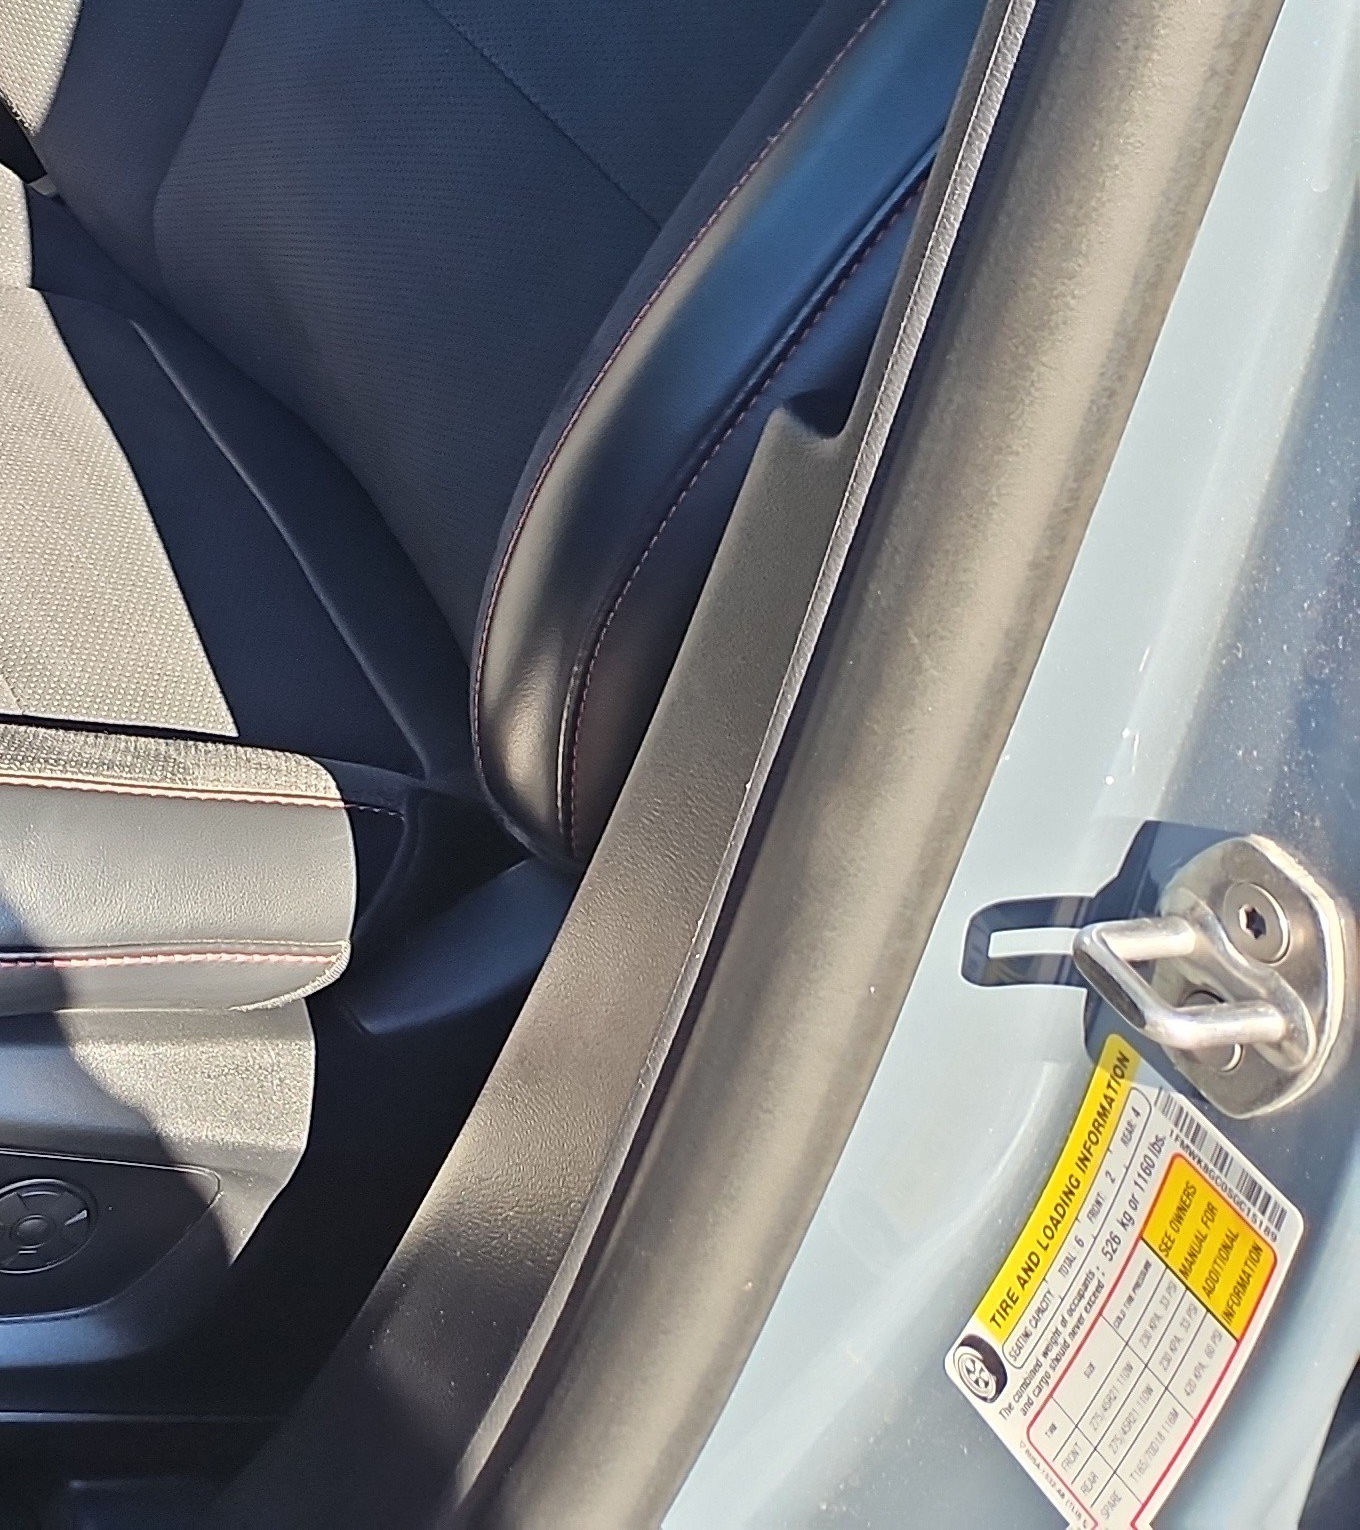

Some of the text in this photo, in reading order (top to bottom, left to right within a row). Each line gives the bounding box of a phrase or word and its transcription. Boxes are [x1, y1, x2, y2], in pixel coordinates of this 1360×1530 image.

[1131, 1105, 1141, 1119] 4
[989, 1050, 1130, 1329] TIRE AND LOADING INFORMATION
[1101, 1133, 1167, 1262] 526 kg or 1160 lbs.
[1105, 1170, 1116, 1184] 2
[1074, 1234, 1085, 1249] 6
[1158, 1180, 1197, 1258] SEE OWNERS
[1178, 1201, 1219, 1281] MANUAL FOR
[1200, 1228, 1240, 1299] ADDITIONAL
[1221, 1239, 1264, 1325] INFORMATION
[998, 1268, 1096, 1421] The combined weight of occupants
[1008, 1288, 1055, 1362] SEATING CAPACITY
[1020, 1396, 1035, 1417] and
[1032, 1370, 1053, 1397] cargo
[1048, 1337, 1071, 1371] should
[1067, 1312, 1086, 1342] never
[1061, 1441, 1082, 1471] FRONT
[1099, 1489, 1123, 1520] SPARE
